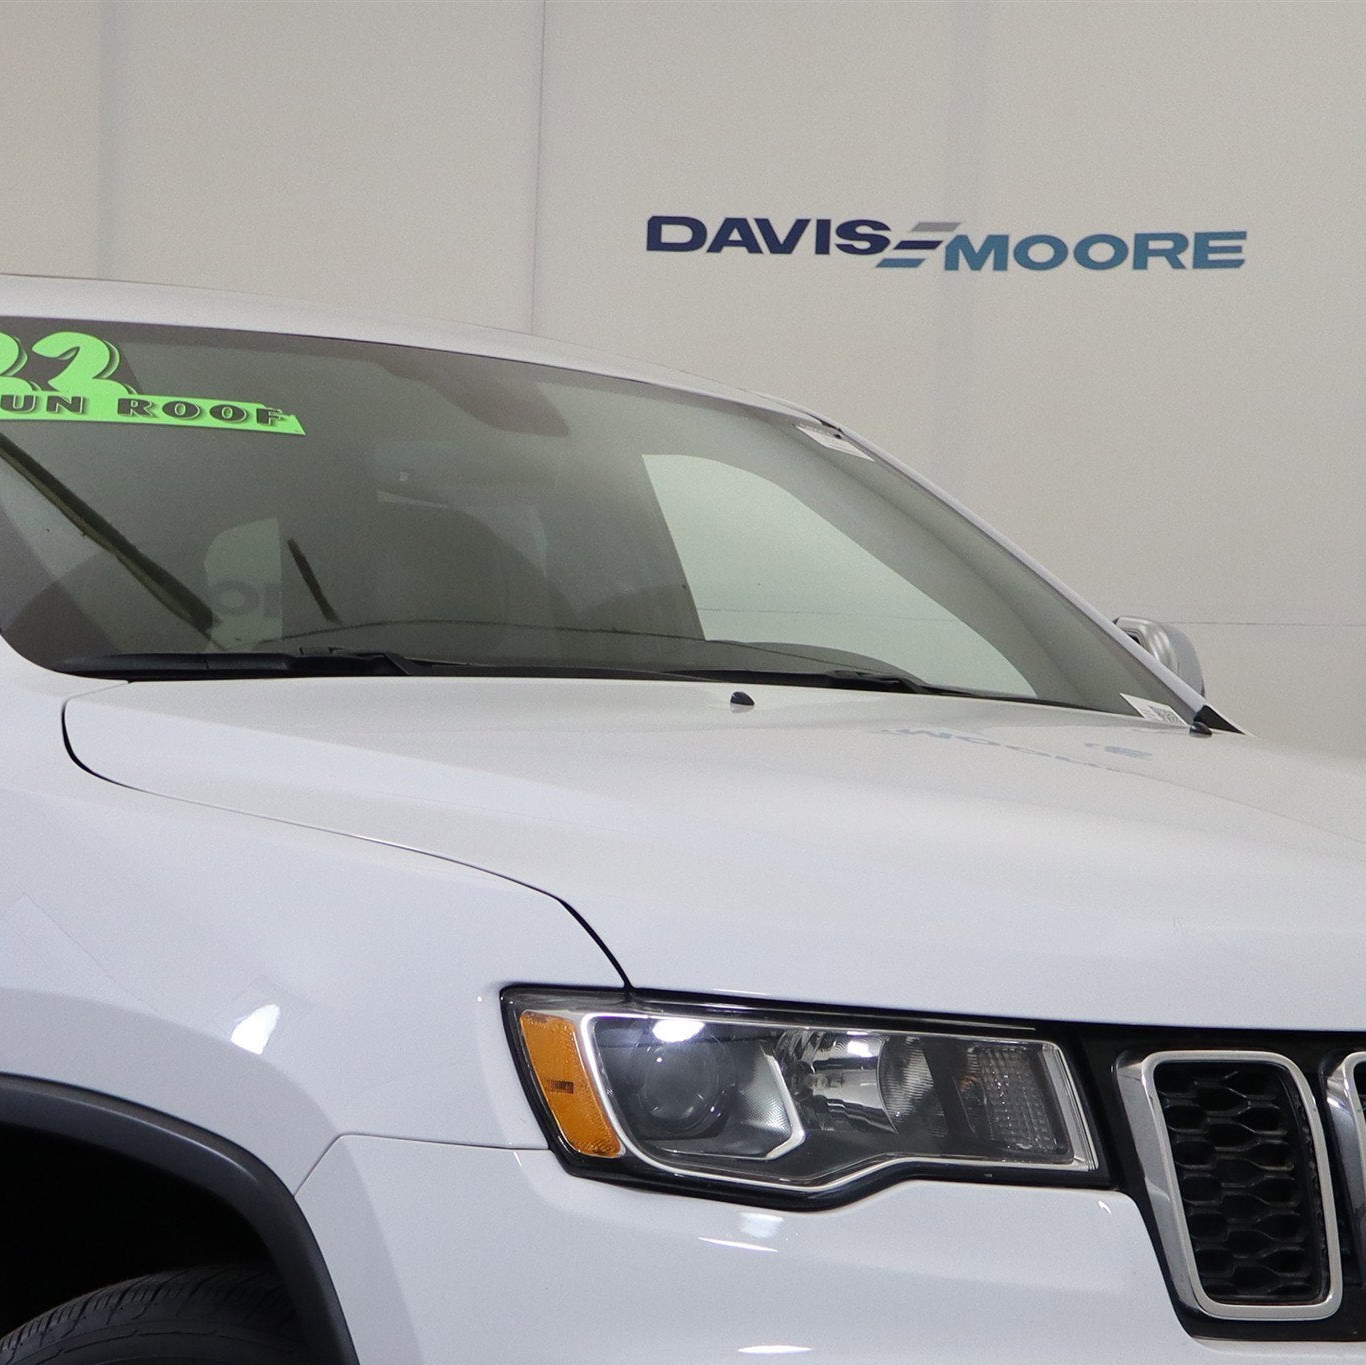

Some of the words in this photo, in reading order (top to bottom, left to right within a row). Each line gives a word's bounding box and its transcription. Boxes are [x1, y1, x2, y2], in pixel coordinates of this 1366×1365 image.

[646, 215, 892, 256] DAVIS
[944, 230, 1248, 272] MOORE
[116, 397, 290, 427] ROOF
